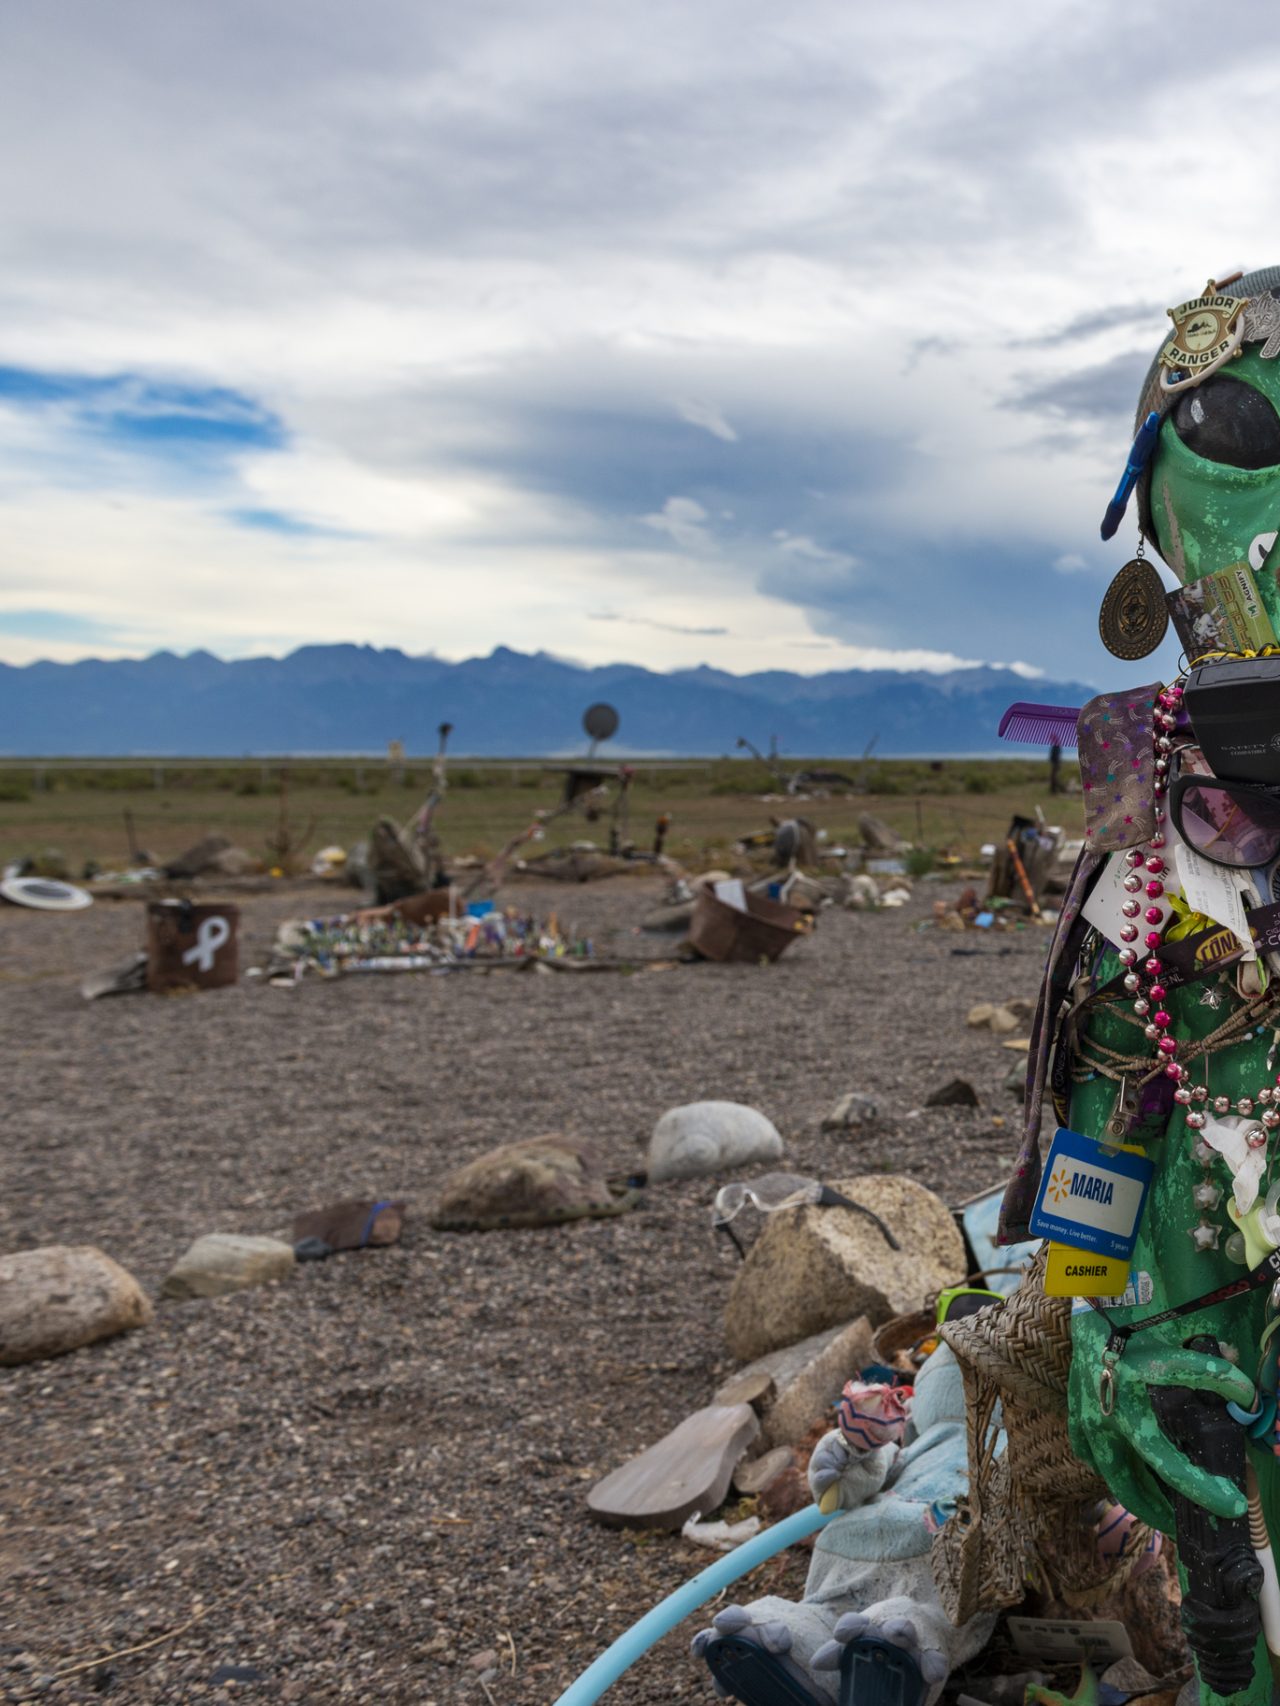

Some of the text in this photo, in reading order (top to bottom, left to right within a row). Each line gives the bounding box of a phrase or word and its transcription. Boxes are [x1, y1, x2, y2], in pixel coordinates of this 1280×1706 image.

[1180, 297, 1235, 315] JUNIOR
[1169, 340, 1230, 365] RANGER
[1070, 1172, 1114, 1206] MARIA
[1036, 1219, 1098, 1243] Save money. Live better.
[1115, 1242, 1129, 1252] years
[1065, 1265, 1108, 1277] CASHIER
